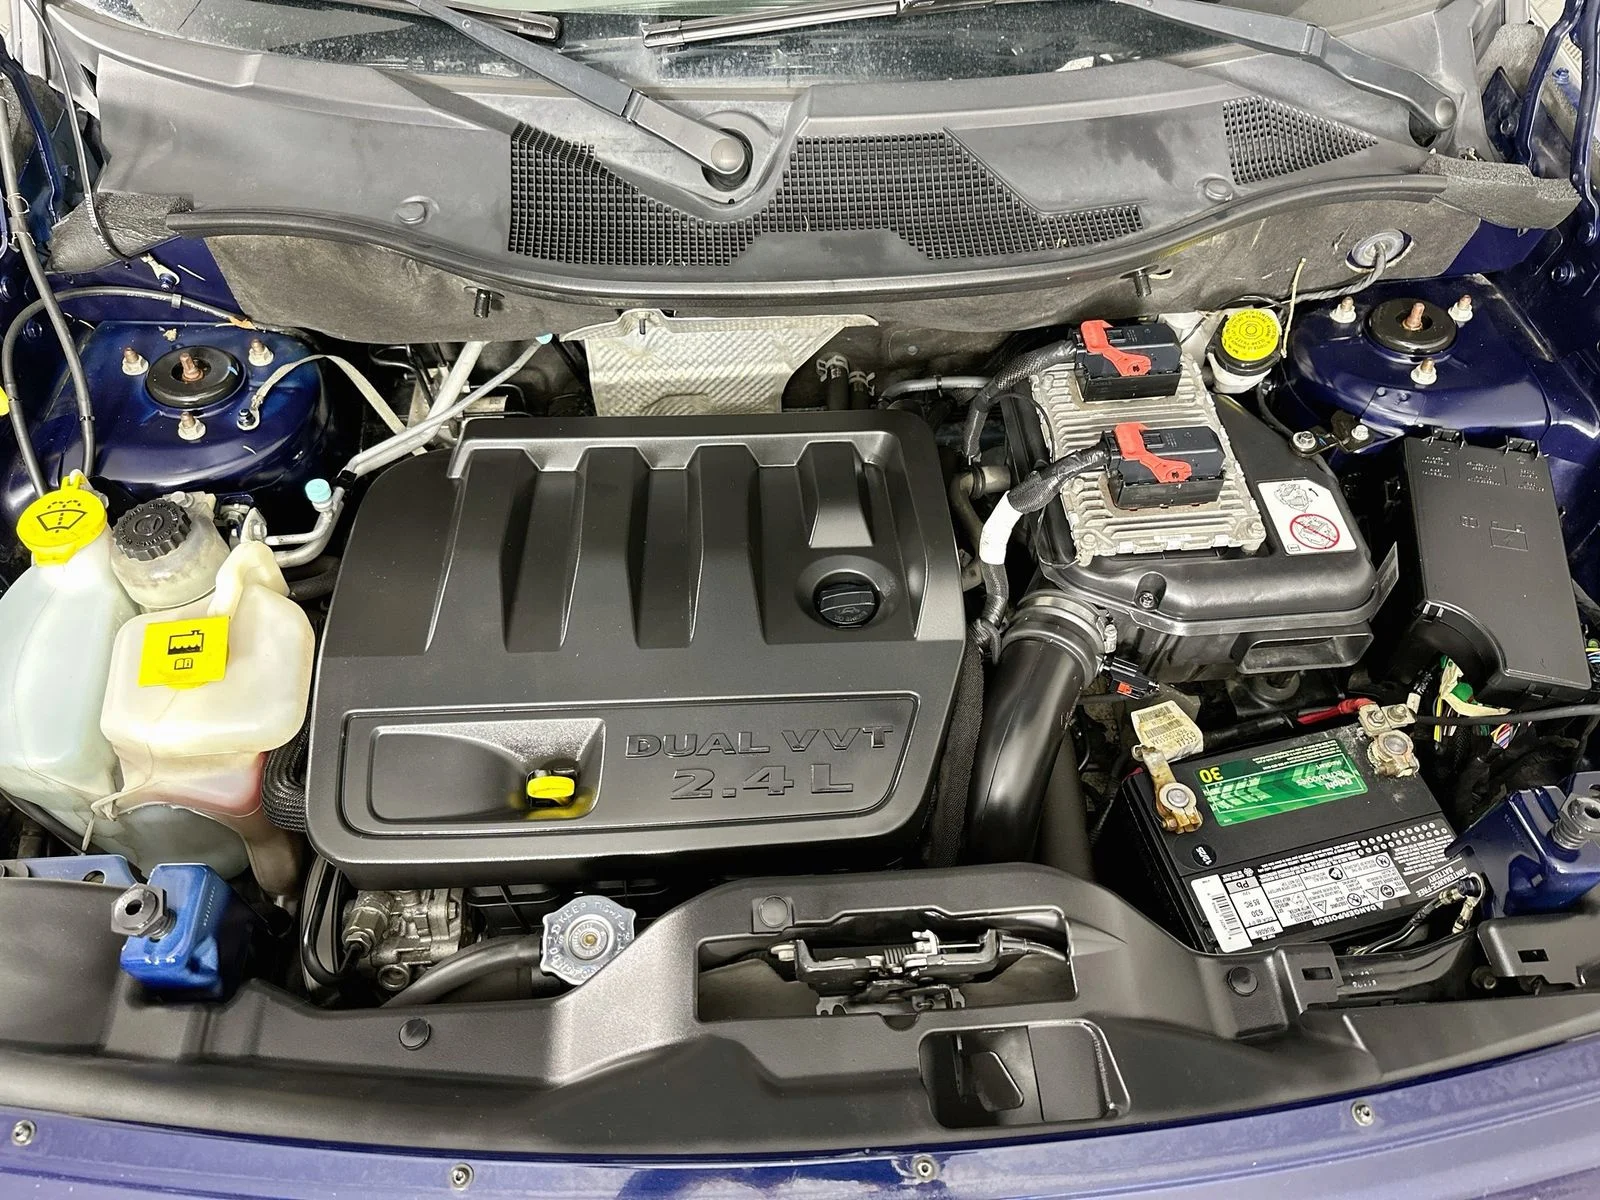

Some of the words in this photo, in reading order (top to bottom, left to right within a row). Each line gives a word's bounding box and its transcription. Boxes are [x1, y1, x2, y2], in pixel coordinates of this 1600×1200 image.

[625, 731, 770, 758] DUAL
[781, 725, 894, 752] VVT
[670, 764, 795, 800] 2.4
[811, 763, 854, 794] L
[1199, 767, 1224, 783] 30
[1295, 769, 1347, 787] Technologies
[1324, 777, 1353, 790] Delphi
[1195, 846, 1212, 866] 12/25
[1428, 866, 1454, 884] BATTERY
[1235, 880, 1250, 889] Pb
[559, 902, 587, 924] KEEP
[1250, 909, 1264, 917] 630
[1311, 903, 1377, 927] DANGER/POISON
